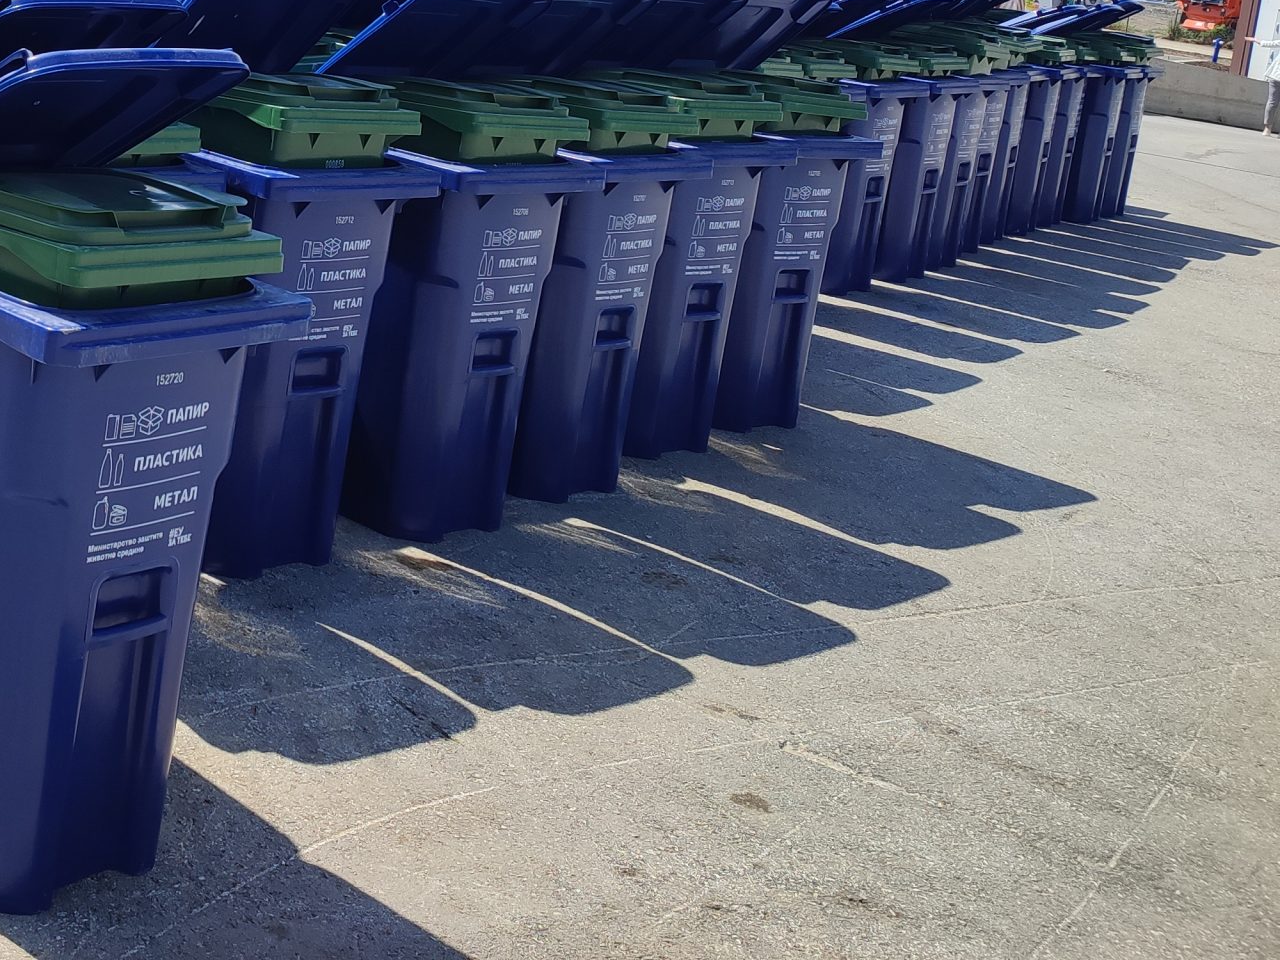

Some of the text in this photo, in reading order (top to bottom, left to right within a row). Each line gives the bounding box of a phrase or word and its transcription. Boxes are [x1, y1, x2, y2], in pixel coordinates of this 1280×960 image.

[636, 214, 657, 225] ПАПИР
[796, 209, 828, 218] ПЛАСТИКА
[335, 215, 355, 225] 152712
[708, 220, 740, 230] ПЛАСТИКА
[518, 229, 543, 241] ПАПИР
[803, 230, 825, 239] МЕТАЛ
[342, 239, 372, 252] ПАПИР
[620, 239, 653, 251] ПЛАСТИКА
[716, 242, 737, 253] МЕТАЛ
[498, 256, 537, 269] ПЛАСТИКА
[320, 267, 367, 282] ПЛАСТИКА
[627, 263, 649, 275] МЕТАЛ
[508, 283, 534, 295] МЕТАЛ
[333, 296, 363, 311] МЕТАЛ
[156, 371, 184, 386] 152720
[166, 401, 210, 425] ПАПИР
[133, 443, 203, 473] ПЛАСТИКА
[153, 485, 198, 511] МЕТАЛ
